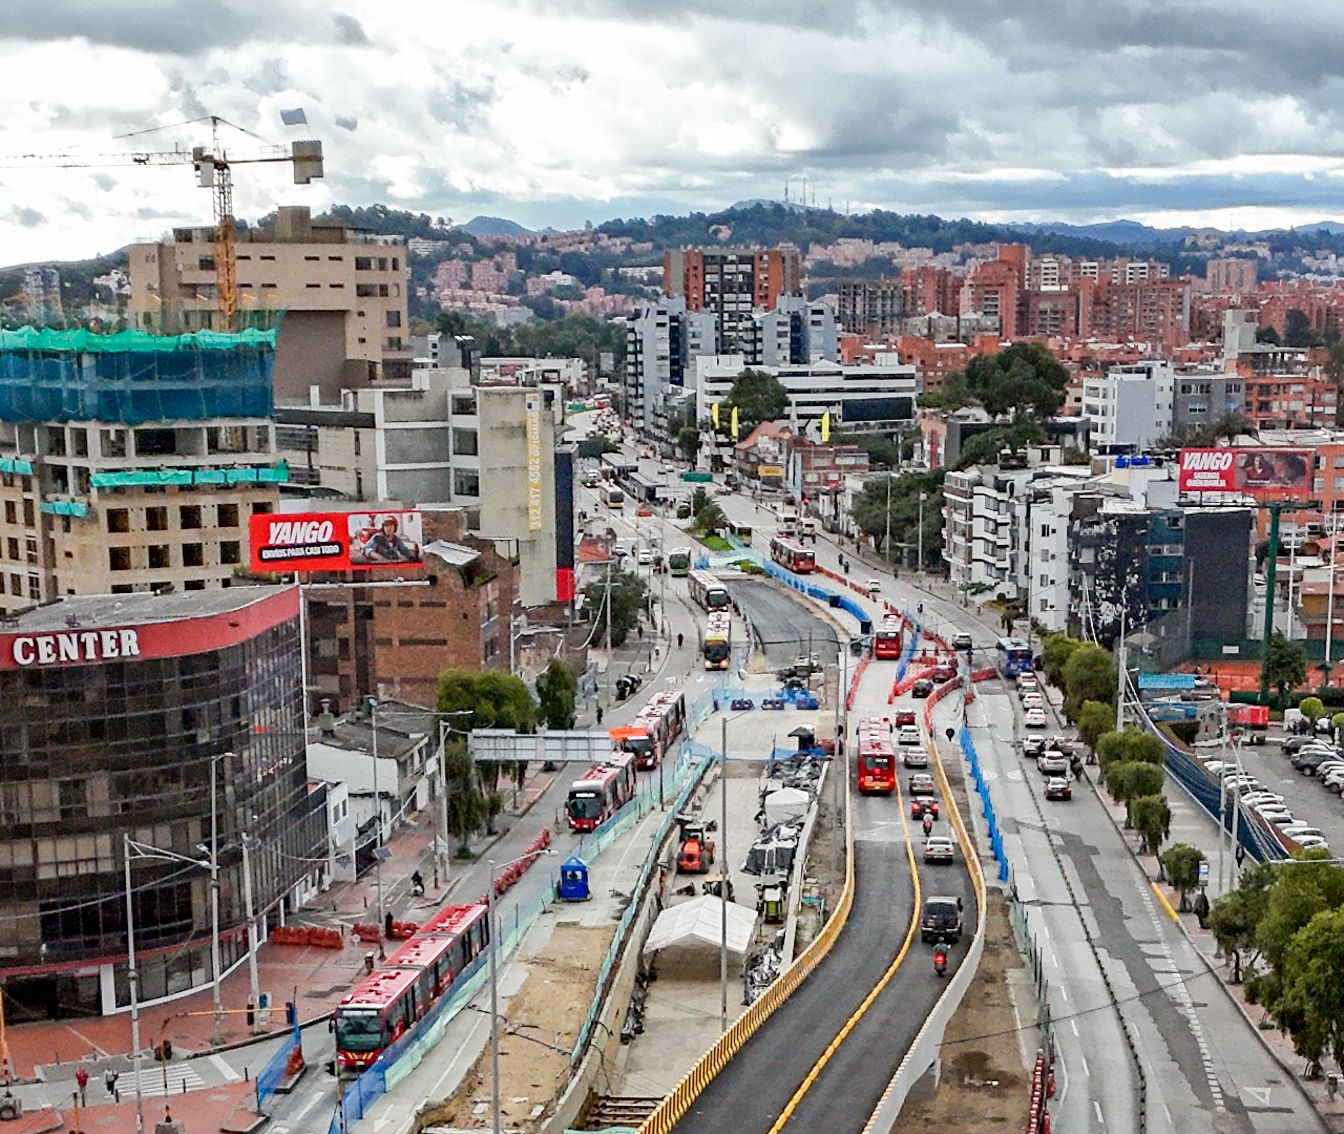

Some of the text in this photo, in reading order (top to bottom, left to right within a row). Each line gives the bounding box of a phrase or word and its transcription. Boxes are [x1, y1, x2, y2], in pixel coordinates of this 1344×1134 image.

[1183, 452, 1233, 471] YANGO
[268, 520, 333, 544] YANGO
[13, 629, 141, 666] CENTER
